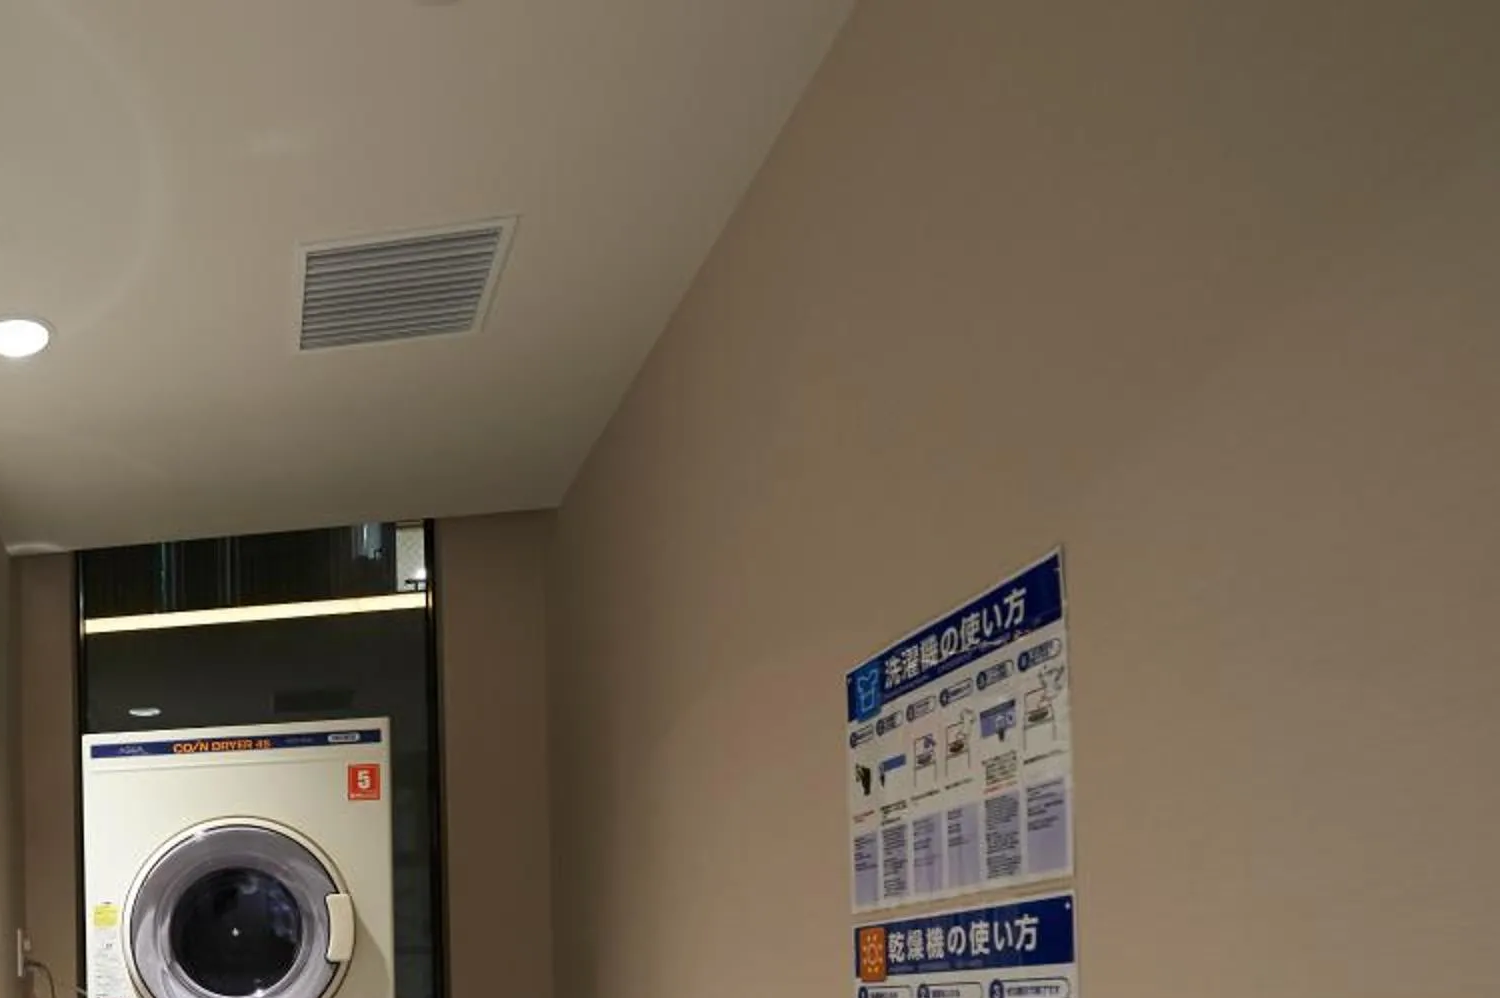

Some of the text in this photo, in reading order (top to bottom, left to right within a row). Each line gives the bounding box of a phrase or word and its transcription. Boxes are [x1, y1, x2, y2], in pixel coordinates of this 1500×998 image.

[357, 769, 371, 790] 5
[887, 915, 1039, 963] 乾燥機の使い方
